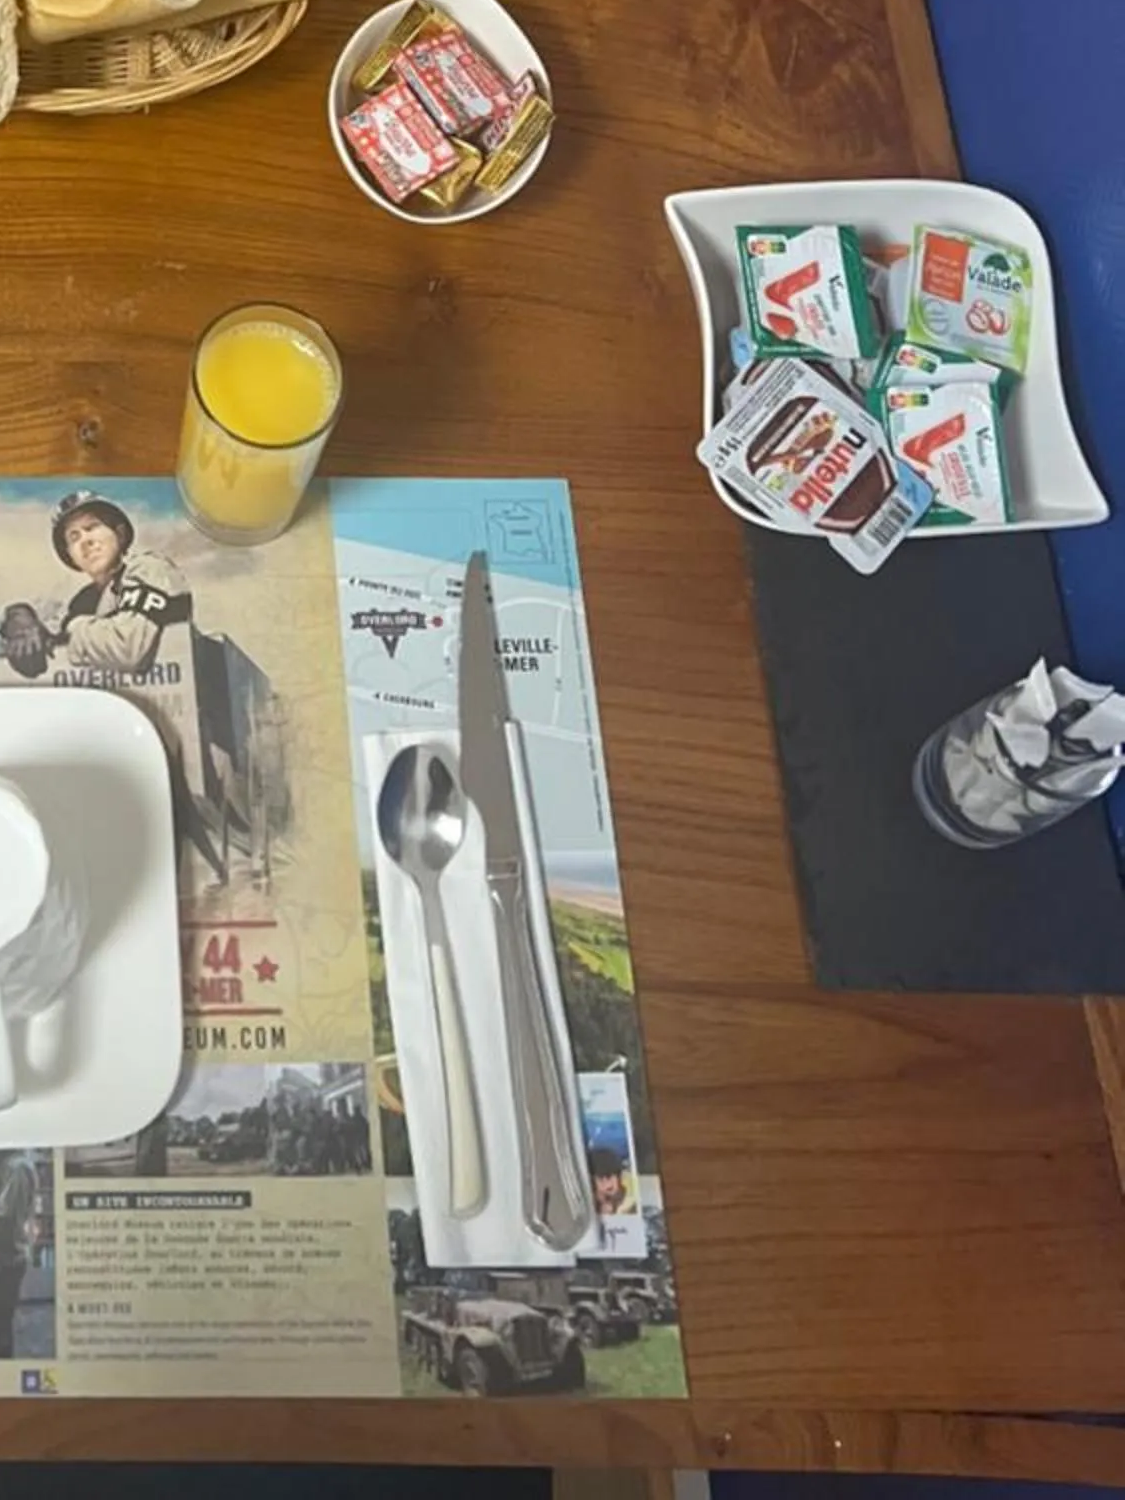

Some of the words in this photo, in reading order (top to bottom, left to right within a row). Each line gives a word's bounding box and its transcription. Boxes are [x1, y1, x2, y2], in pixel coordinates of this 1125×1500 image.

[789, 427, 868, 515] nutella
[494, 638, 559, 654] LEVILLE-
[202, 934, 241, 974] 44
[194, 976, 244, 1004] -MER
[183, 1026, 286, 1050] EUM.COM
